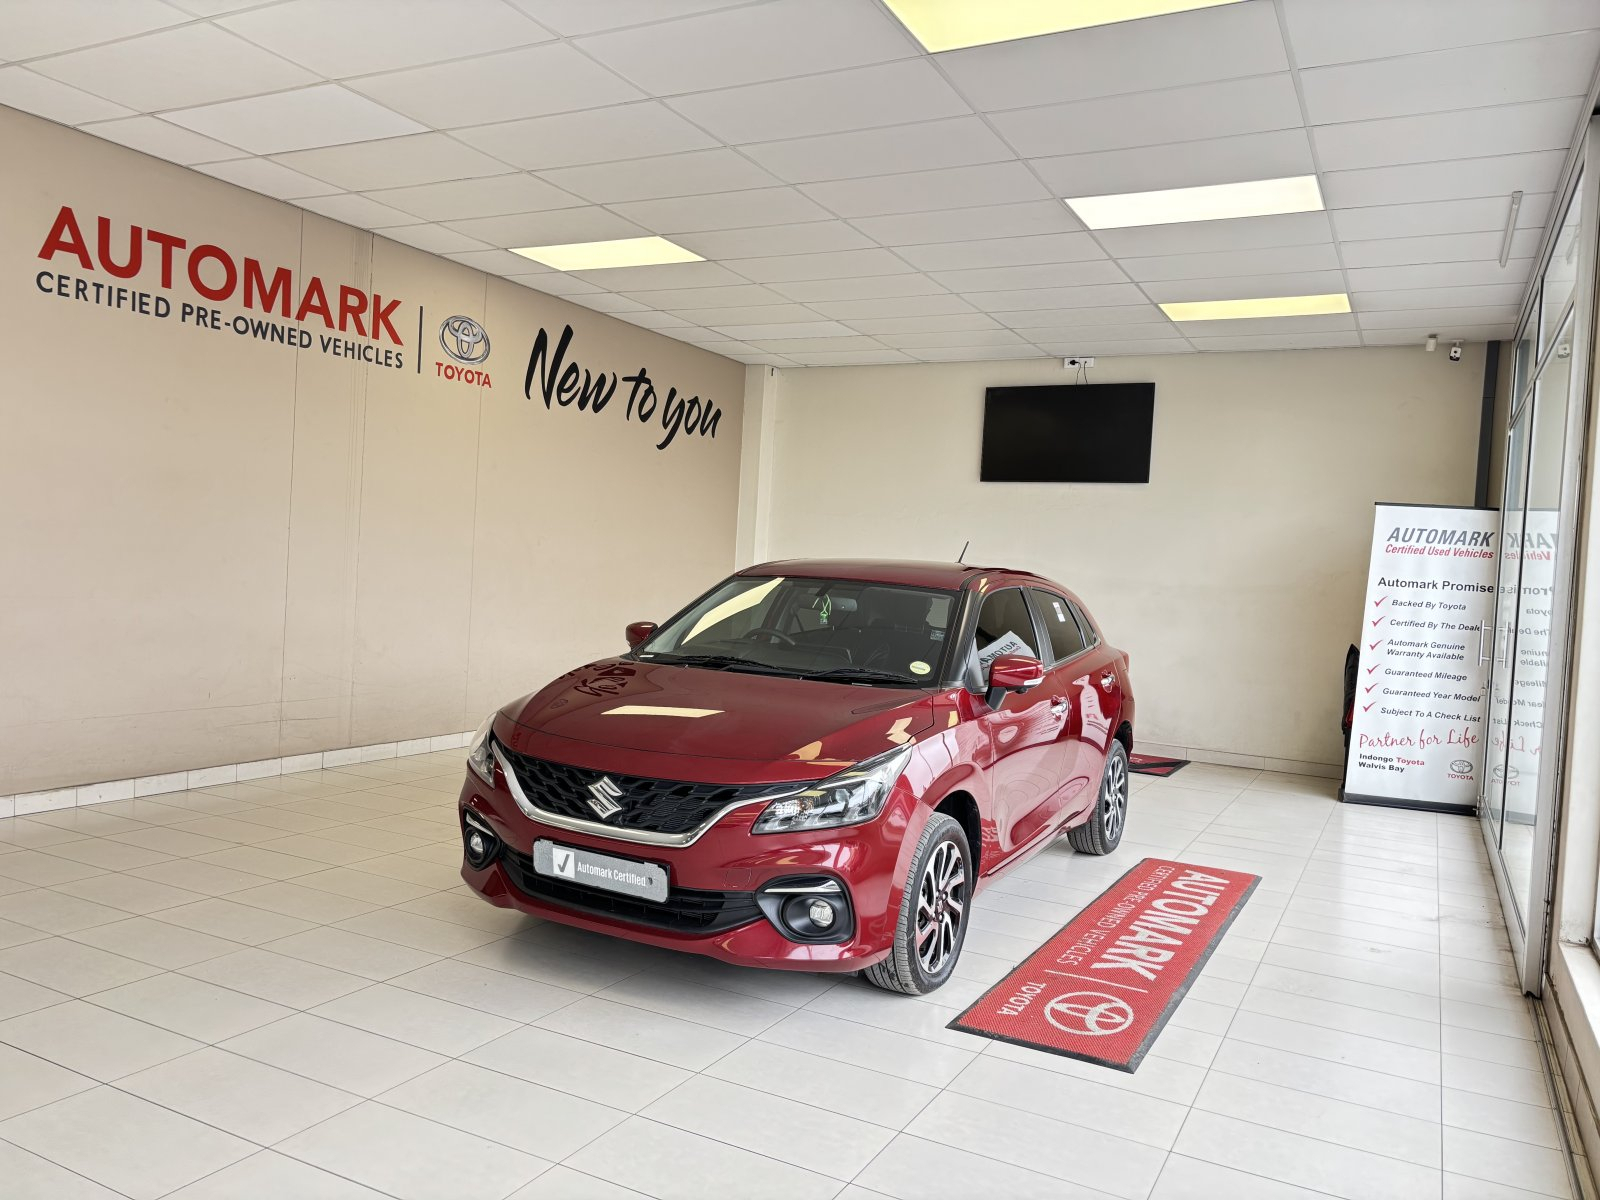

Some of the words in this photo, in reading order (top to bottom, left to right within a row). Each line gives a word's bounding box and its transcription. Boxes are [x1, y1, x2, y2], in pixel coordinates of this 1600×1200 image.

[38, 205, 404, 346] AUTOMARK
[36, 271, 171, 318] CERTIFIED
[181, 302, 313, 349] PRE-OWNED
[320, 334, 404, 369] VEHICLES
[435, 361, 492, 389] TOYOTA
[525, 324, 618, 414] New
[621, 367, 658, 423] to
[656, 386, 722, 450] you
[1387, 527, 1495, 547] AUTOMARK
[1386, 544, 1425, 555] Certified
[1427, 546, 1450, 557] Used
[1453, 548, 1495, 559] Vehicles
[1378, 577, 1438, 590] Automark
[1442, 580, 1495, 593] Promise
[1392, 599, 1424, 609] Backed
[1425, 601, 1437, 610] By
[1438, 602, 1467, 611] Toyota
[1389, 618, 1428, 629] Certified
[1428, 621, 1439, 631] By
[1441, 622, 1456, 630] The
[1388, 639, 1429, 649] Automark
[1430, 641, 1466, 651] Genuine
[1386, 648, 1424, 660] Warranty
[1425, 651, 1465, 661] Available
[1384, 668, 1433, 679] Guaranteed
[1434, 672, 1468, 682] Mileage
[1383, 687, 1432, 698] Guaranteed
[1433, 691, 1451, 700] Year
[1453, 693, 1481, 703] Model
[1381, 706, 1414, 718] Subject
[1415, 709, 1425, 718] To
[1426, 710, 1433, 718] A
[1435, 711, 1461, 721] Check
[1463, 713, 1482, 723] List
[1358, 730, 1417, 749] Partner
[1417, 728, 1442, 749] for
[1446, 726, 1480, 747] Life
[1358, 761, 1387, 770] Walvis
[1388, 764, 1405, 773] Bay
[1359, 753, 1394, 764] Indongo
[1395, 756, 1425, 766] Toyota
[1447, 773, 1474, 781] TOYOTA
[577, 861, 613, 879] Automark
[613, 869, 647, 887] Certified
[1140, 865, 1175, 891] CERTIFIED
[1097, 887, 1147, 928] PRE-OWNED
[1090, 869, 1230, 982] AUTOMARK
[1056, 926, 1110, 966] VEHICLES
[996, 981, 1047, 1016] TOYOTA
